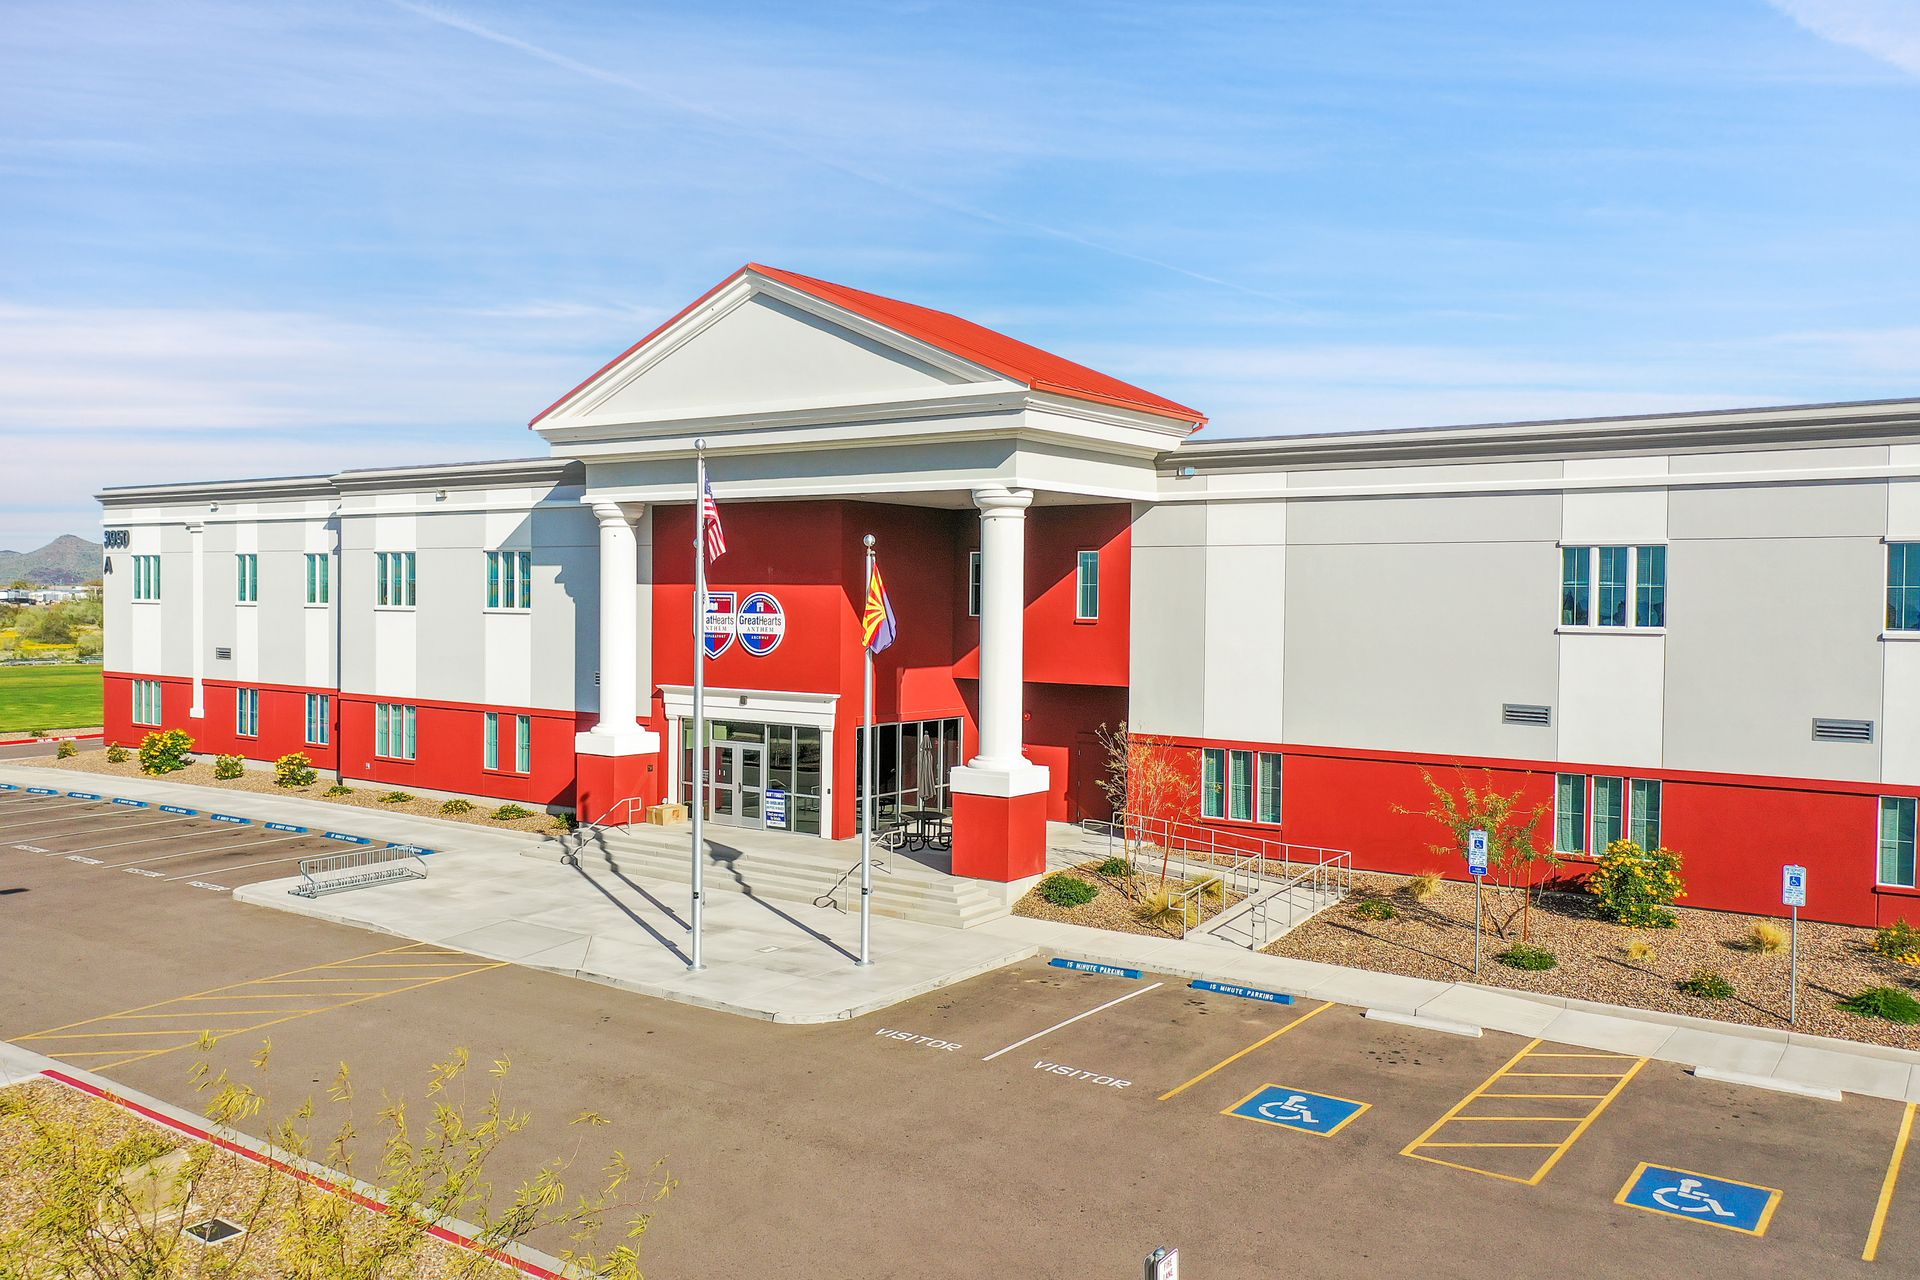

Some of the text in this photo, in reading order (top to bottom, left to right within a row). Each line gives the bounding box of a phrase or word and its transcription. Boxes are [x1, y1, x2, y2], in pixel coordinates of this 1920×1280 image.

[104, 530, 130, 549] 3950
[104, 556, 113, 575] A
[706, 615, 734, 625] atHearts
[739, 615, 782, 626] GreatHearts
[1076, 963, 1097, 972] MINUTE
[1099, 966, 1124, 977] PARKING
[1220, 985, 1243, 994] MINUTE
[1246, 990, 1274, 1000] PARKING
[875, 1028, 963, 1051] VISITOR
[1033, 1061, 1131, 1089] VISITOR
